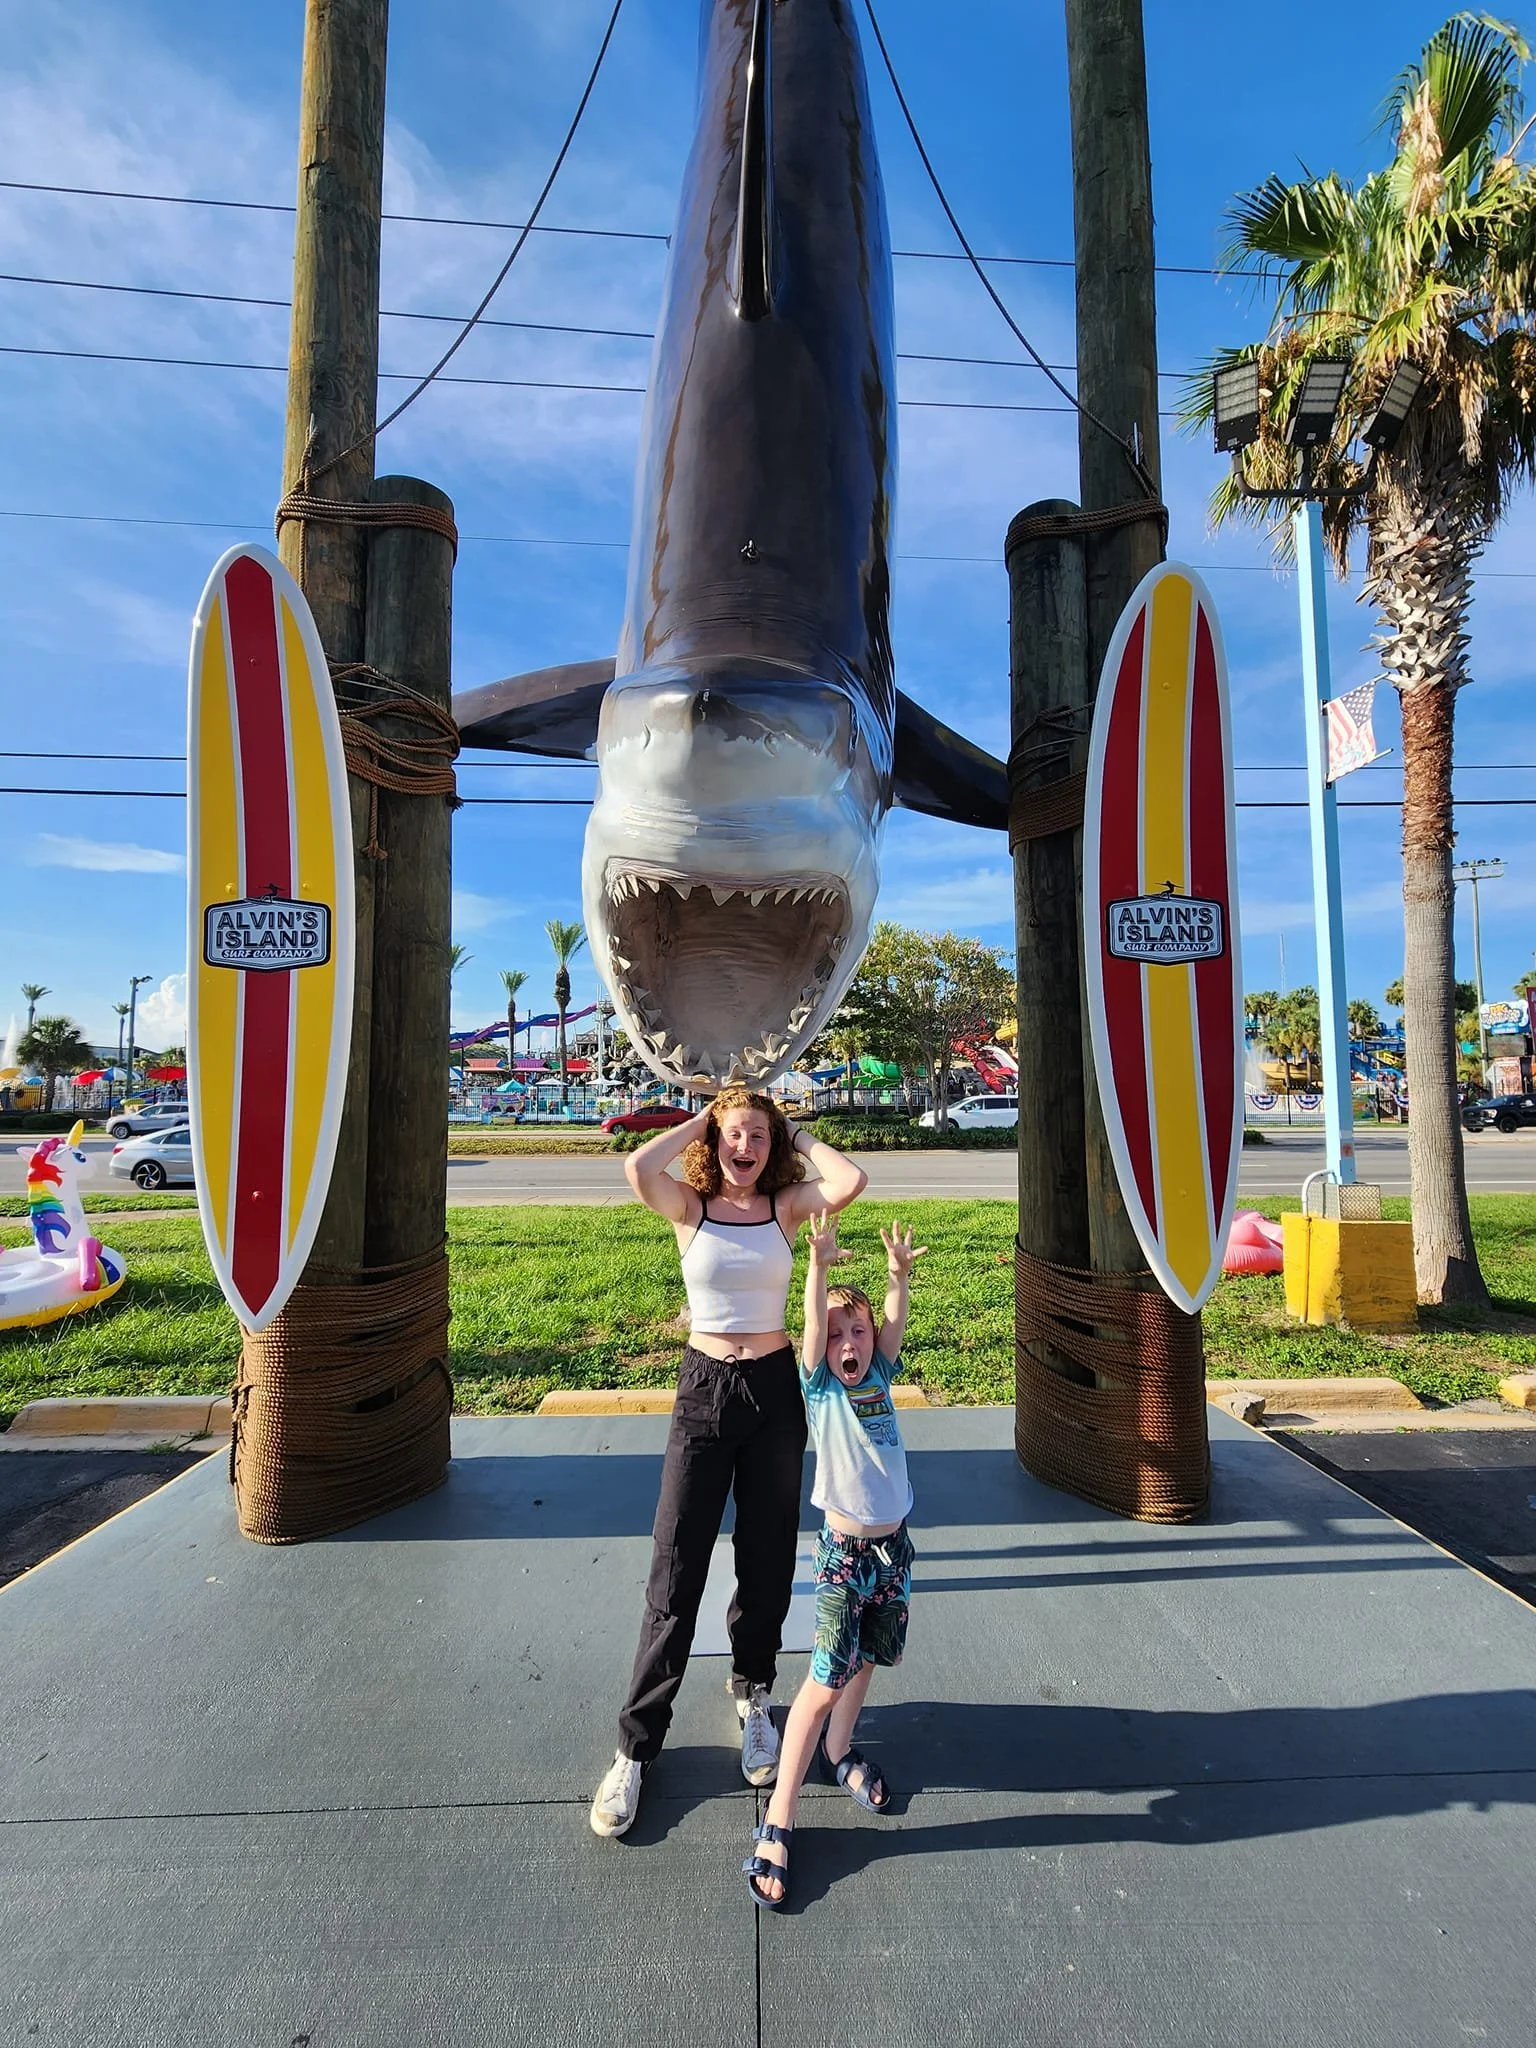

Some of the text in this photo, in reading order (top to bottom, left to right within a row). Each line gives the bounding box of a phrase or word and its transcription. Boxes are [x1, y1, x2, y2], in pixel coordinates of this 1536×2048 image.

[217, 911, 319, 930] ALVIN'S
[1118, 907, 1214, 925] ALVIN'S
[216, 930, 319, 949] ISLAND
[1118, 925, 1215, 943] ISLAND
[223, 949, 310, 958] SURF COMPANY
[1126, 943, 1207, 952] SURF COMPANY
